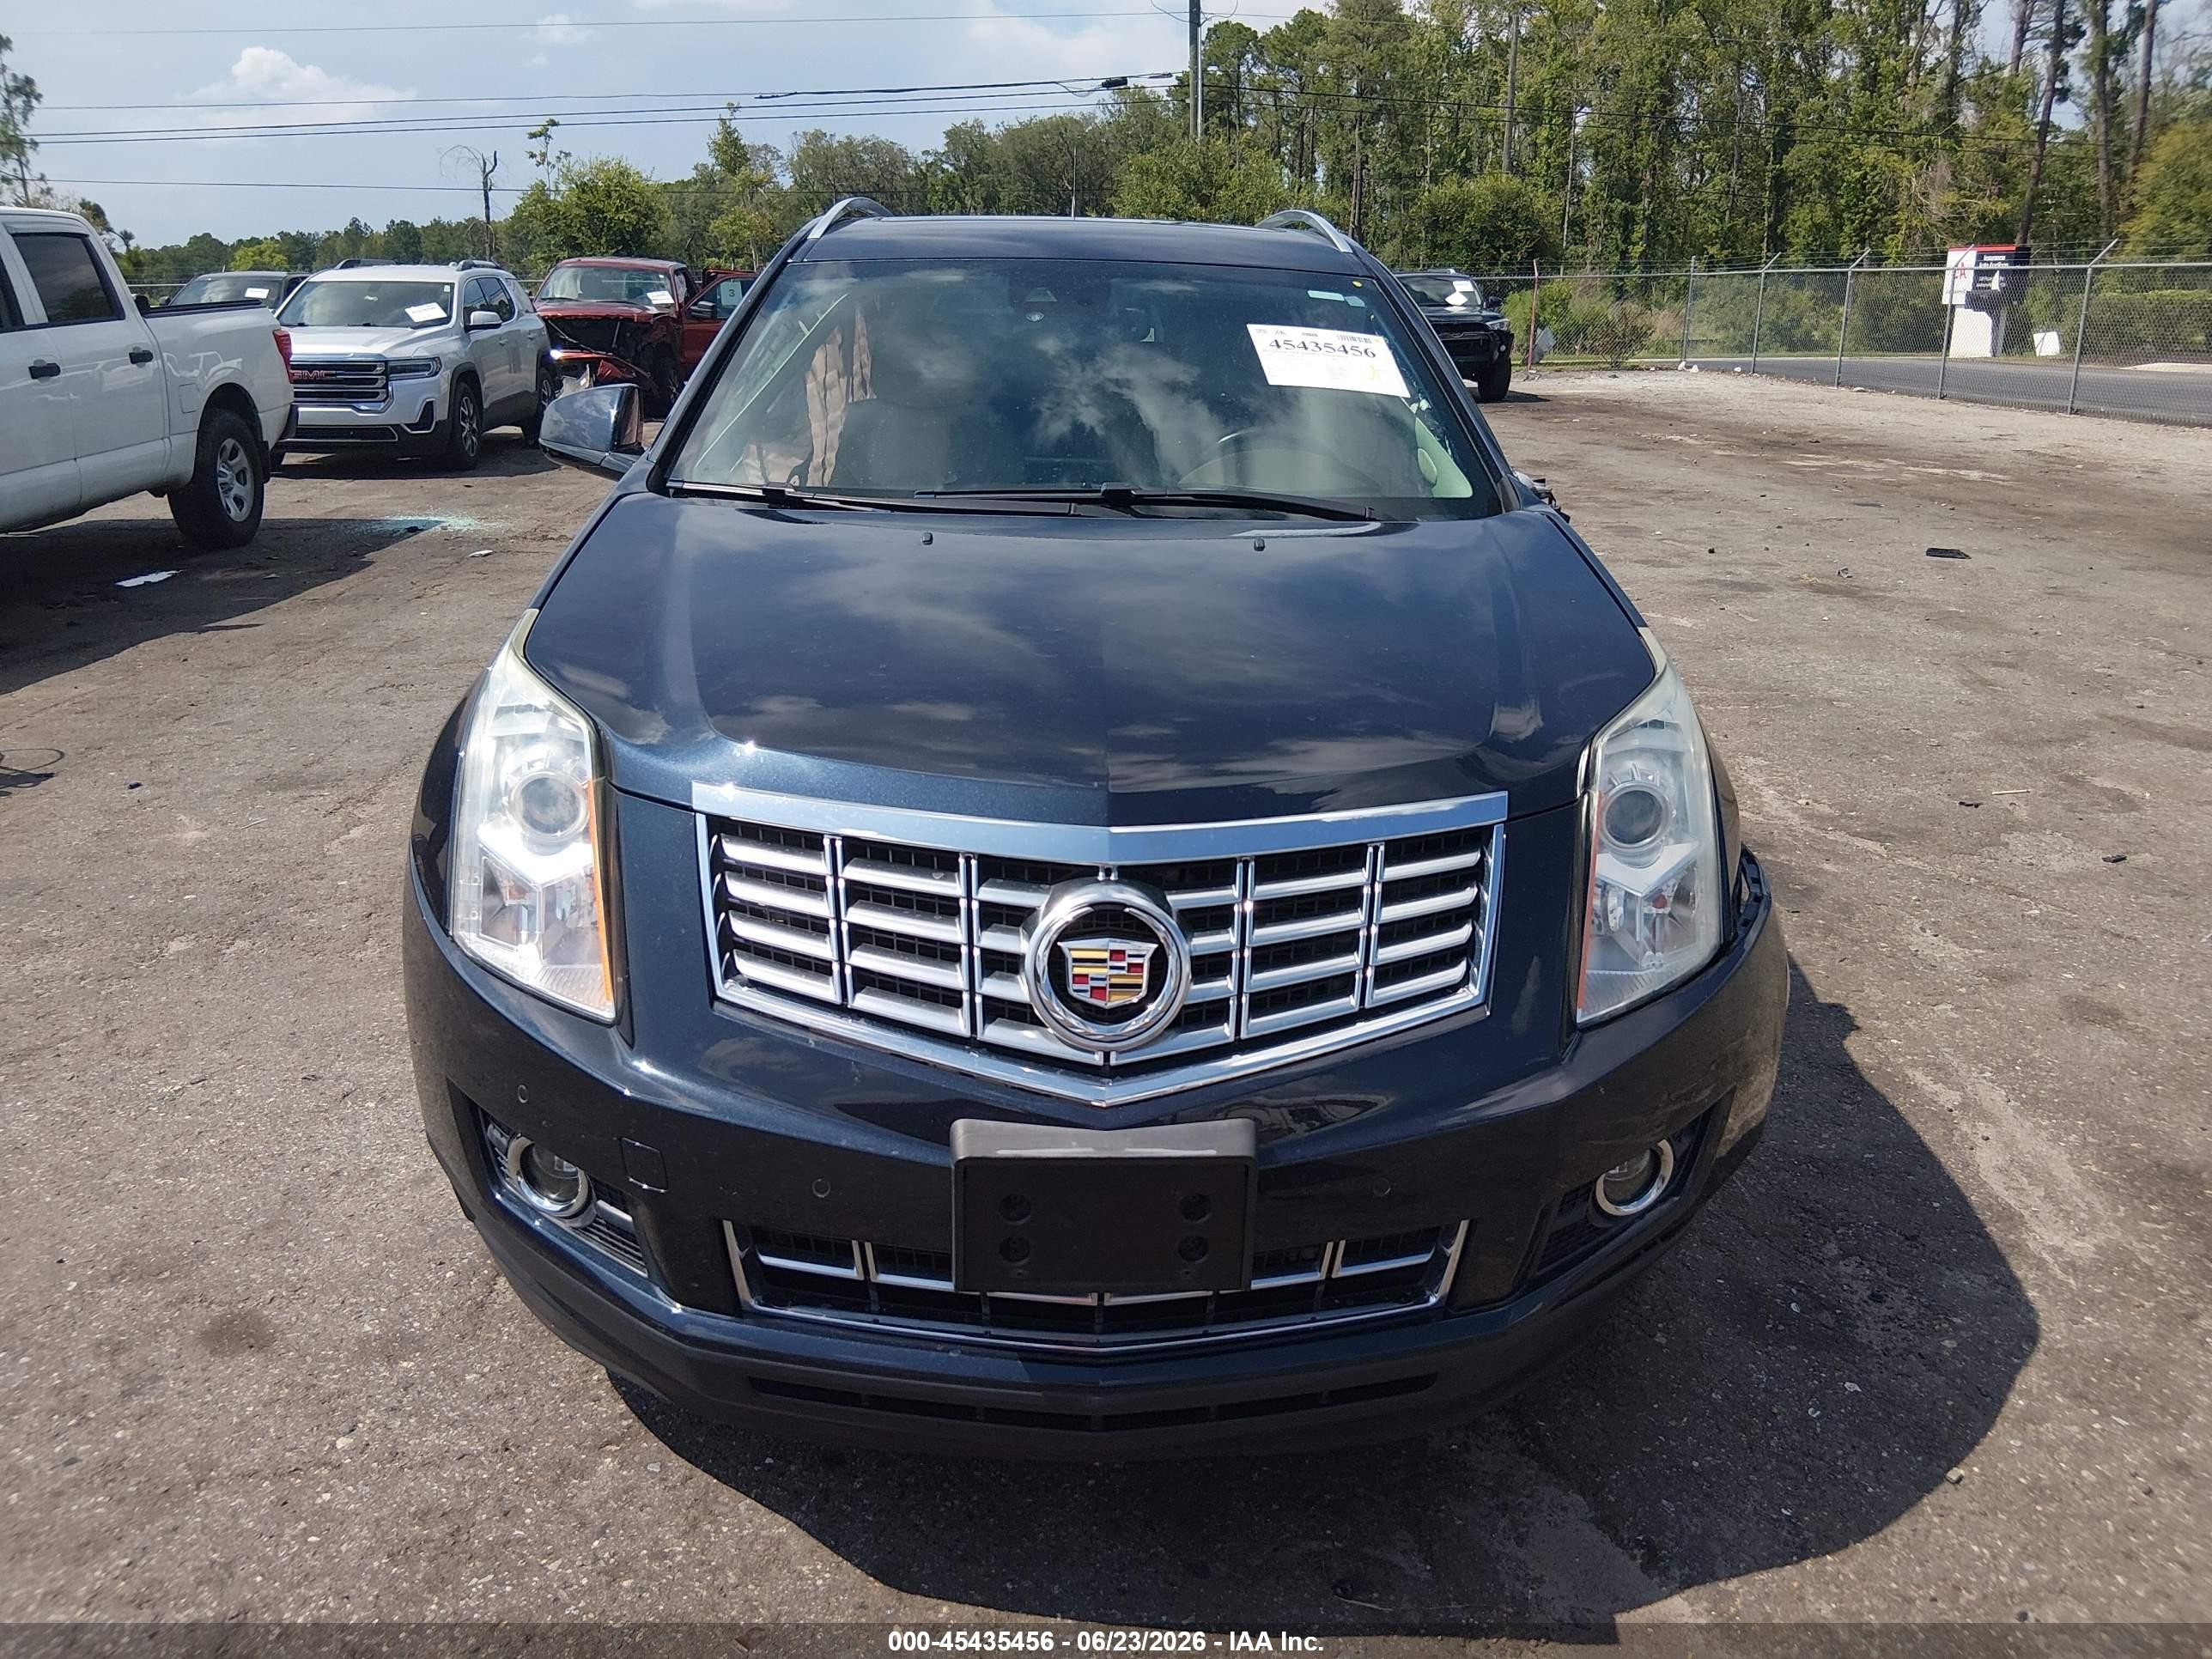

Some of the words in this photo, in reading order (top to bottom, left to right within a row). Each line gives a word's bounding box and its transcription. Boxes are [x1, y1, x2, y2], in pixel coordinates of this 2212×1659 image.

[728, 289, 736, 297] 3
[1269, 338, 1376, 359] 45435456
[289, 369, 337, 380] GMC
